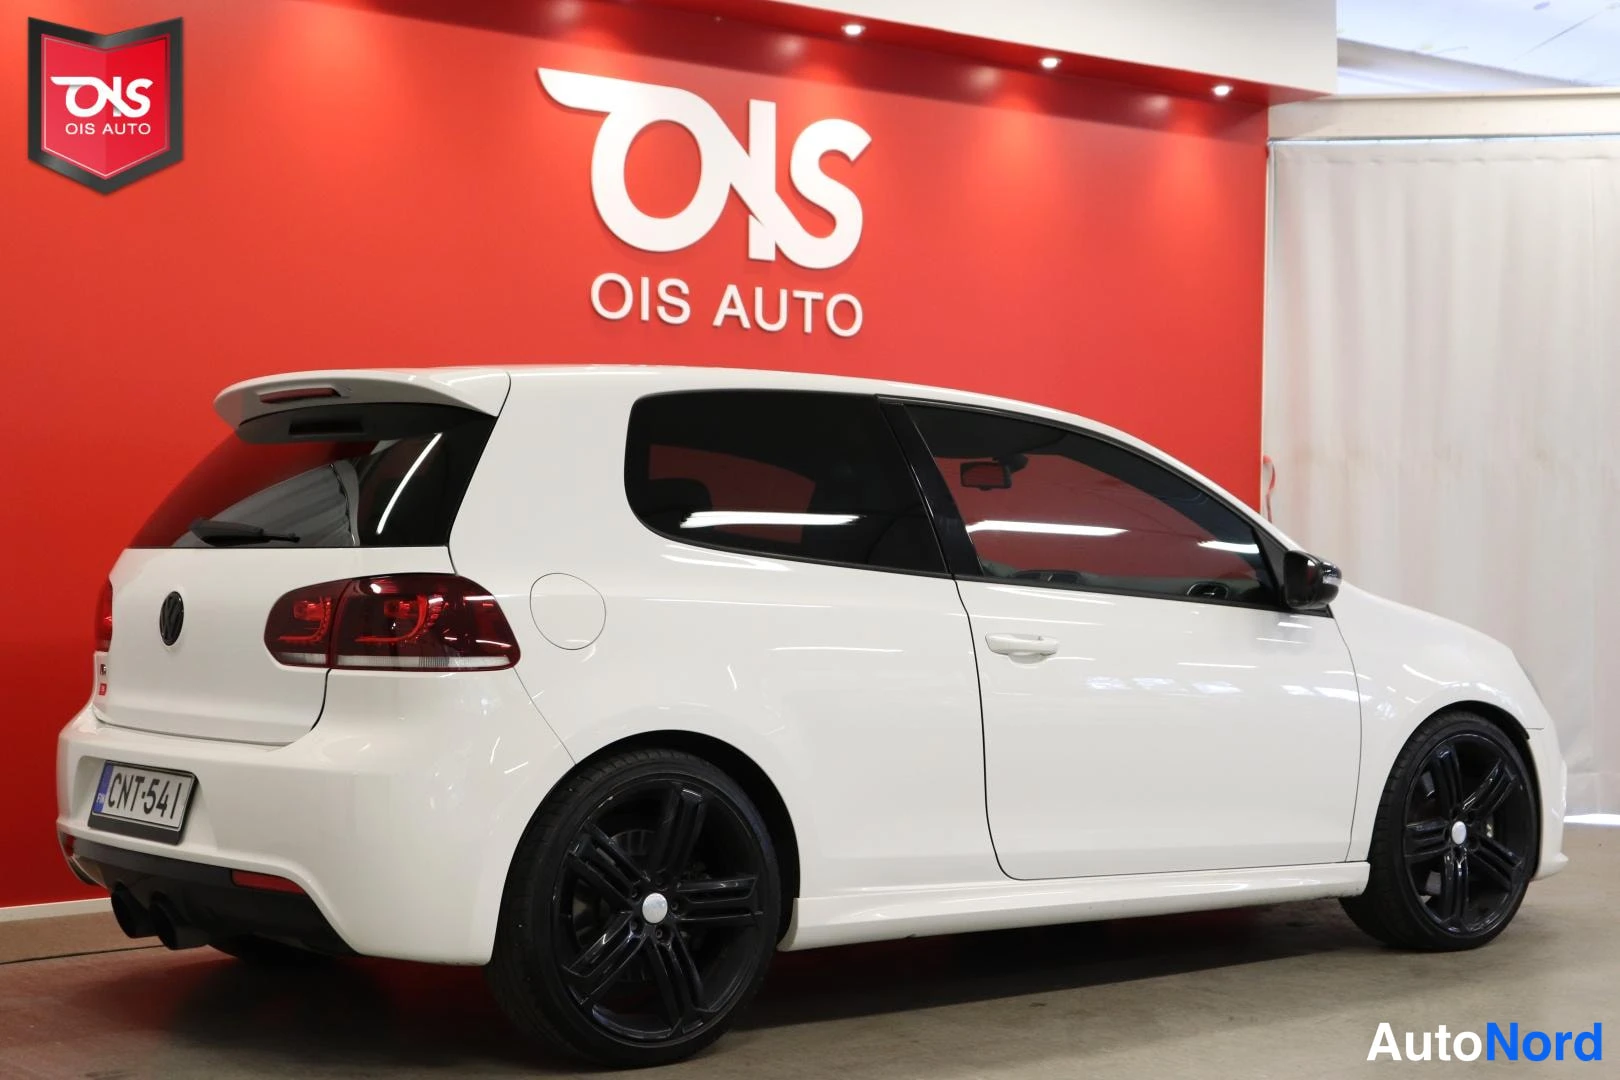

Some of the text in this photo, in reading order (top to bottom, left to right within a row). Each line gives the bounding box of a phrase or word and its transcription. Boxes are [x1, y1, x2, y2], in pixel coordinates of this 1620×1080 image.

[590, 272, 863, 337] OIS AUTO
[108, 773, 182, 819] CNT-541
